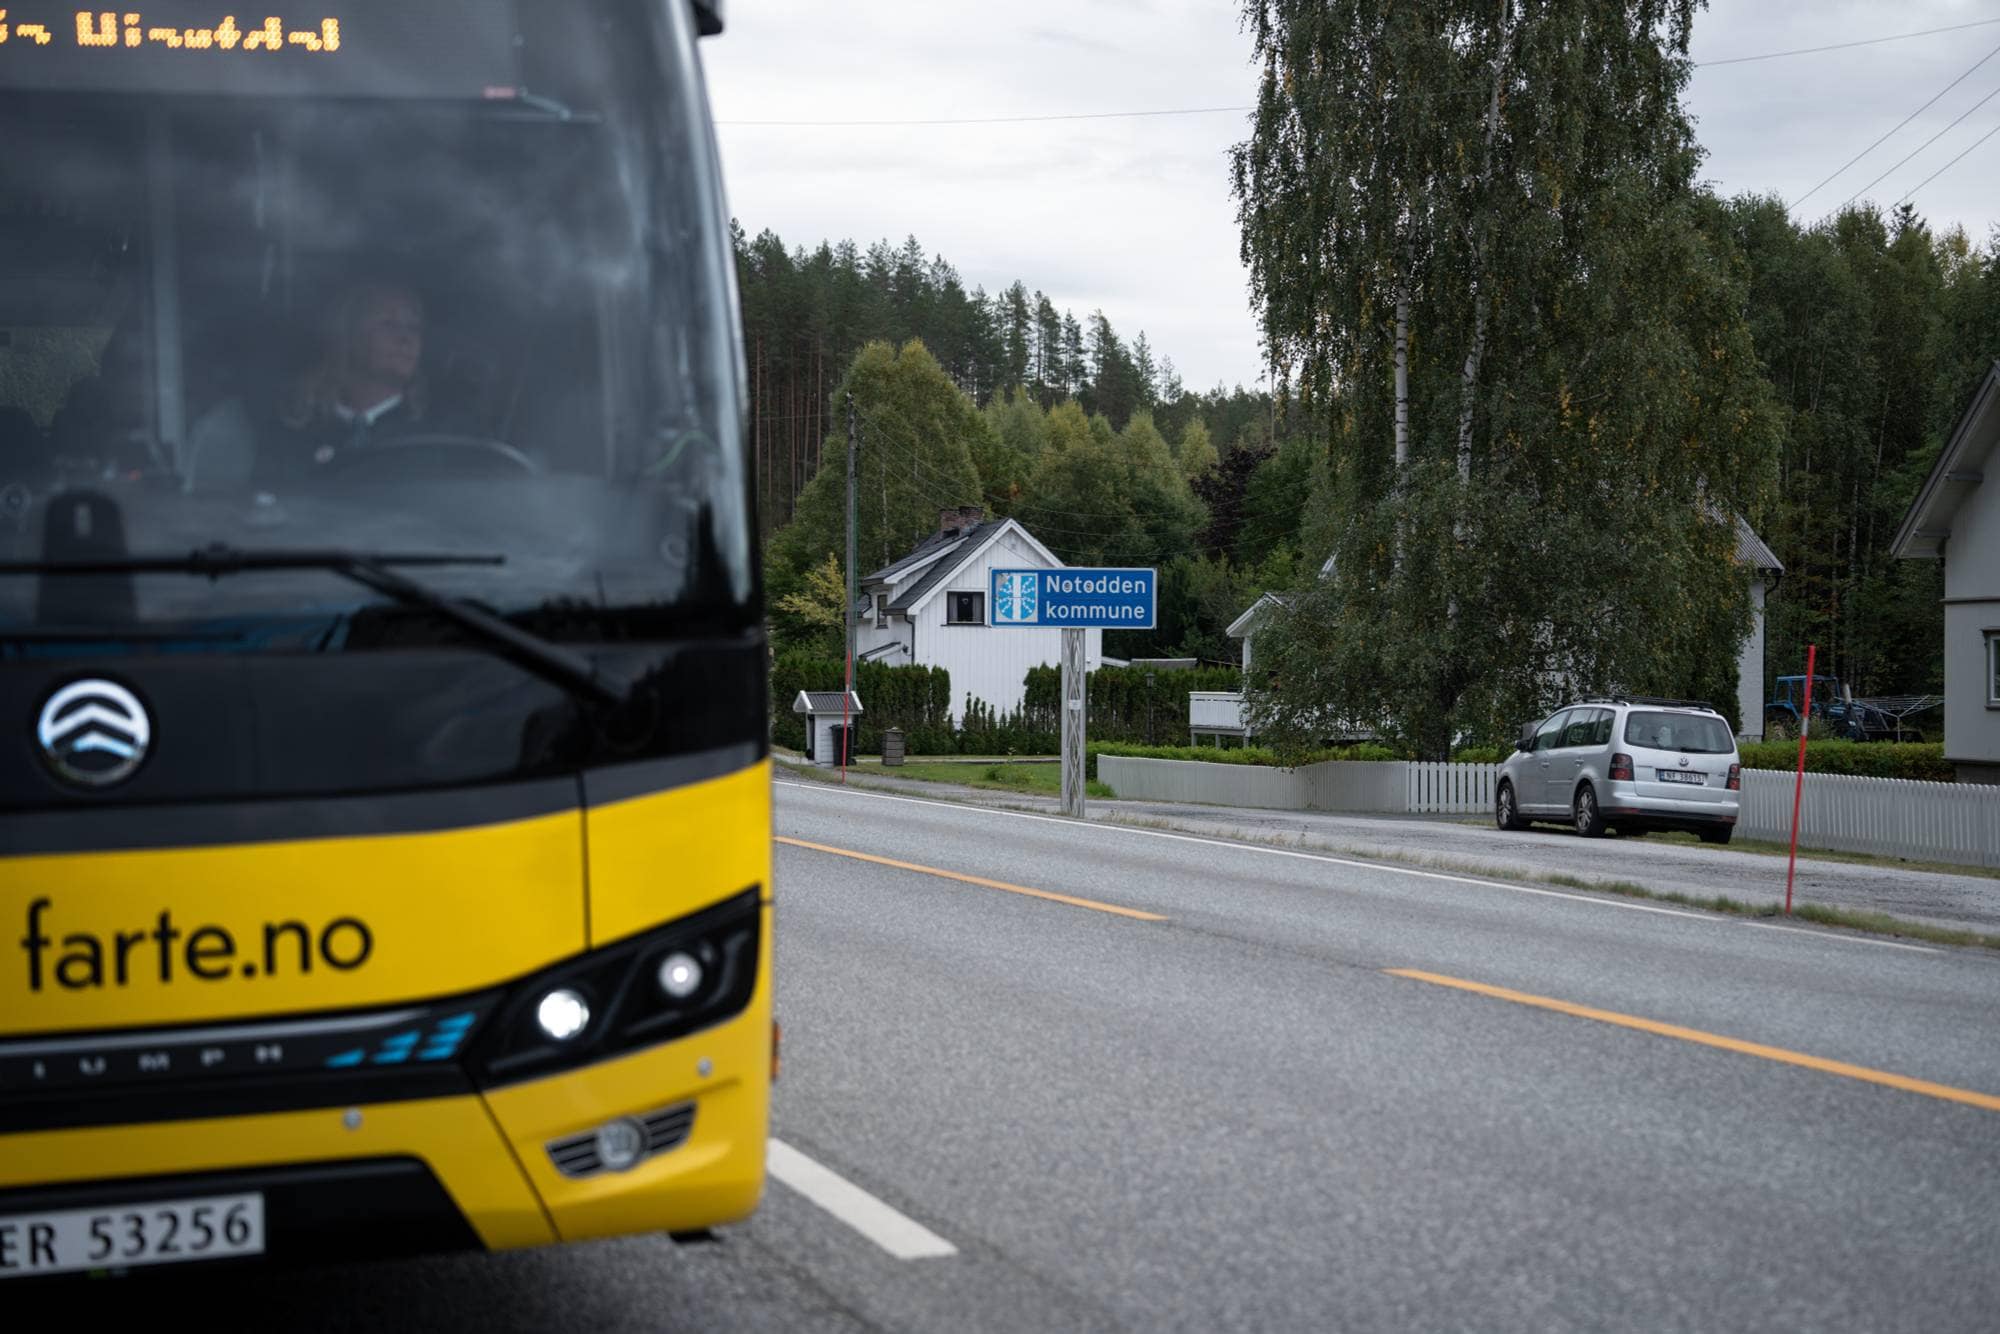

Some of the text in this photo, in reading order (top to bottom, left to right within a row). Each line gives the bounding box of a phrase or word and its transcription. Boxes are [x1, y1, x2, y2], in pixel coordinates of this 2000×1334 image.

[1046, 575, 1146, 594] Notodden
[1046, 601, 1145, 619] kommune
[20, 897, 373, 992] farte.no
[0, 1203, 250, 1268] ER 53256
